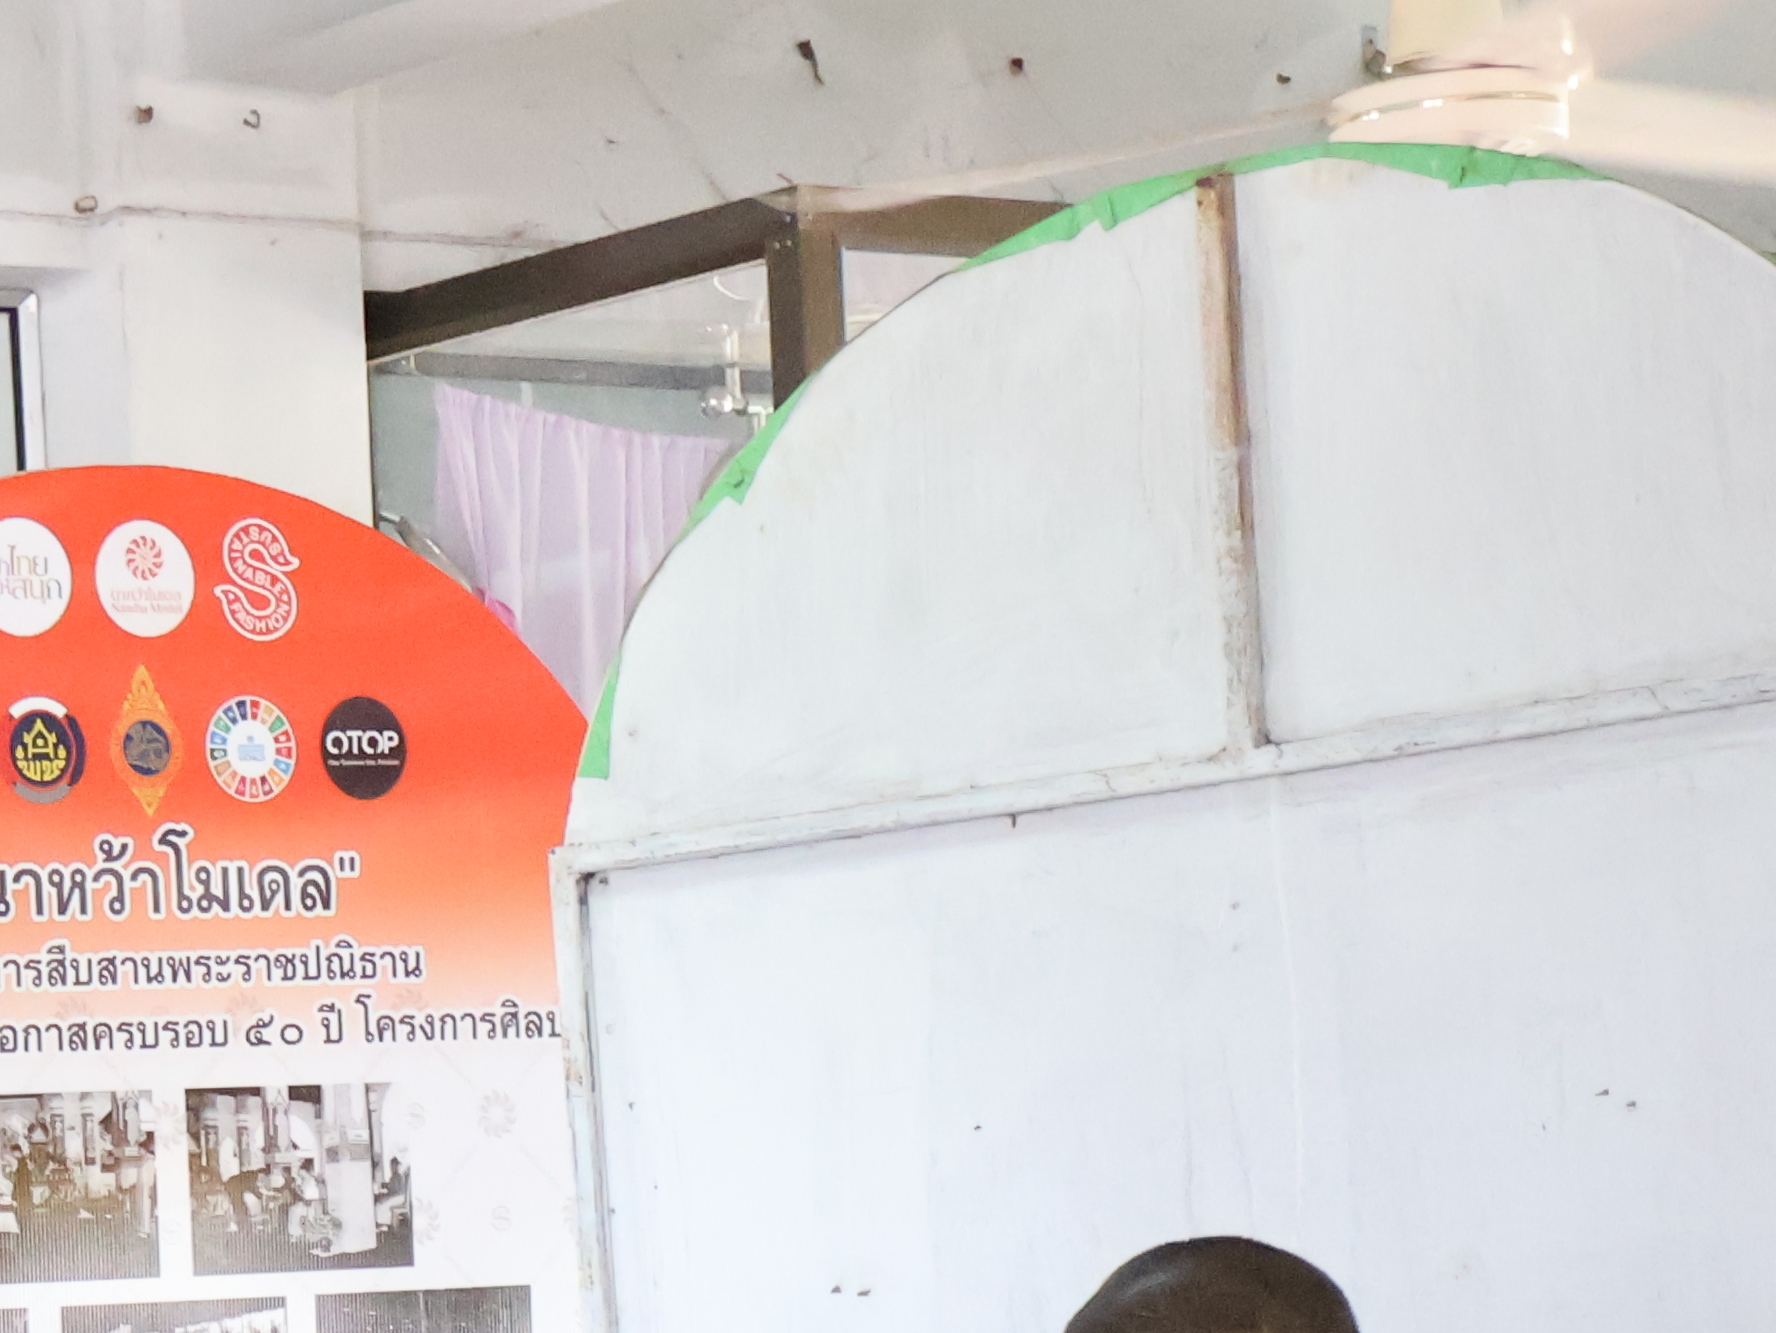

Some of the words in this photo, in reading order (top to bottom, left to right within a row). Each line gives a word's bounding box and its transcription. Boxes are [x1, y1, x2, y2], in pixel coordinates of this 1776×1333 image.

[229, 602, 291, 634] FASHION
[325, 729, 400, 755] OTOP
[245, 1015, 303, 1046] ๕๐
[318, 1003, 343, 1044] ปี
